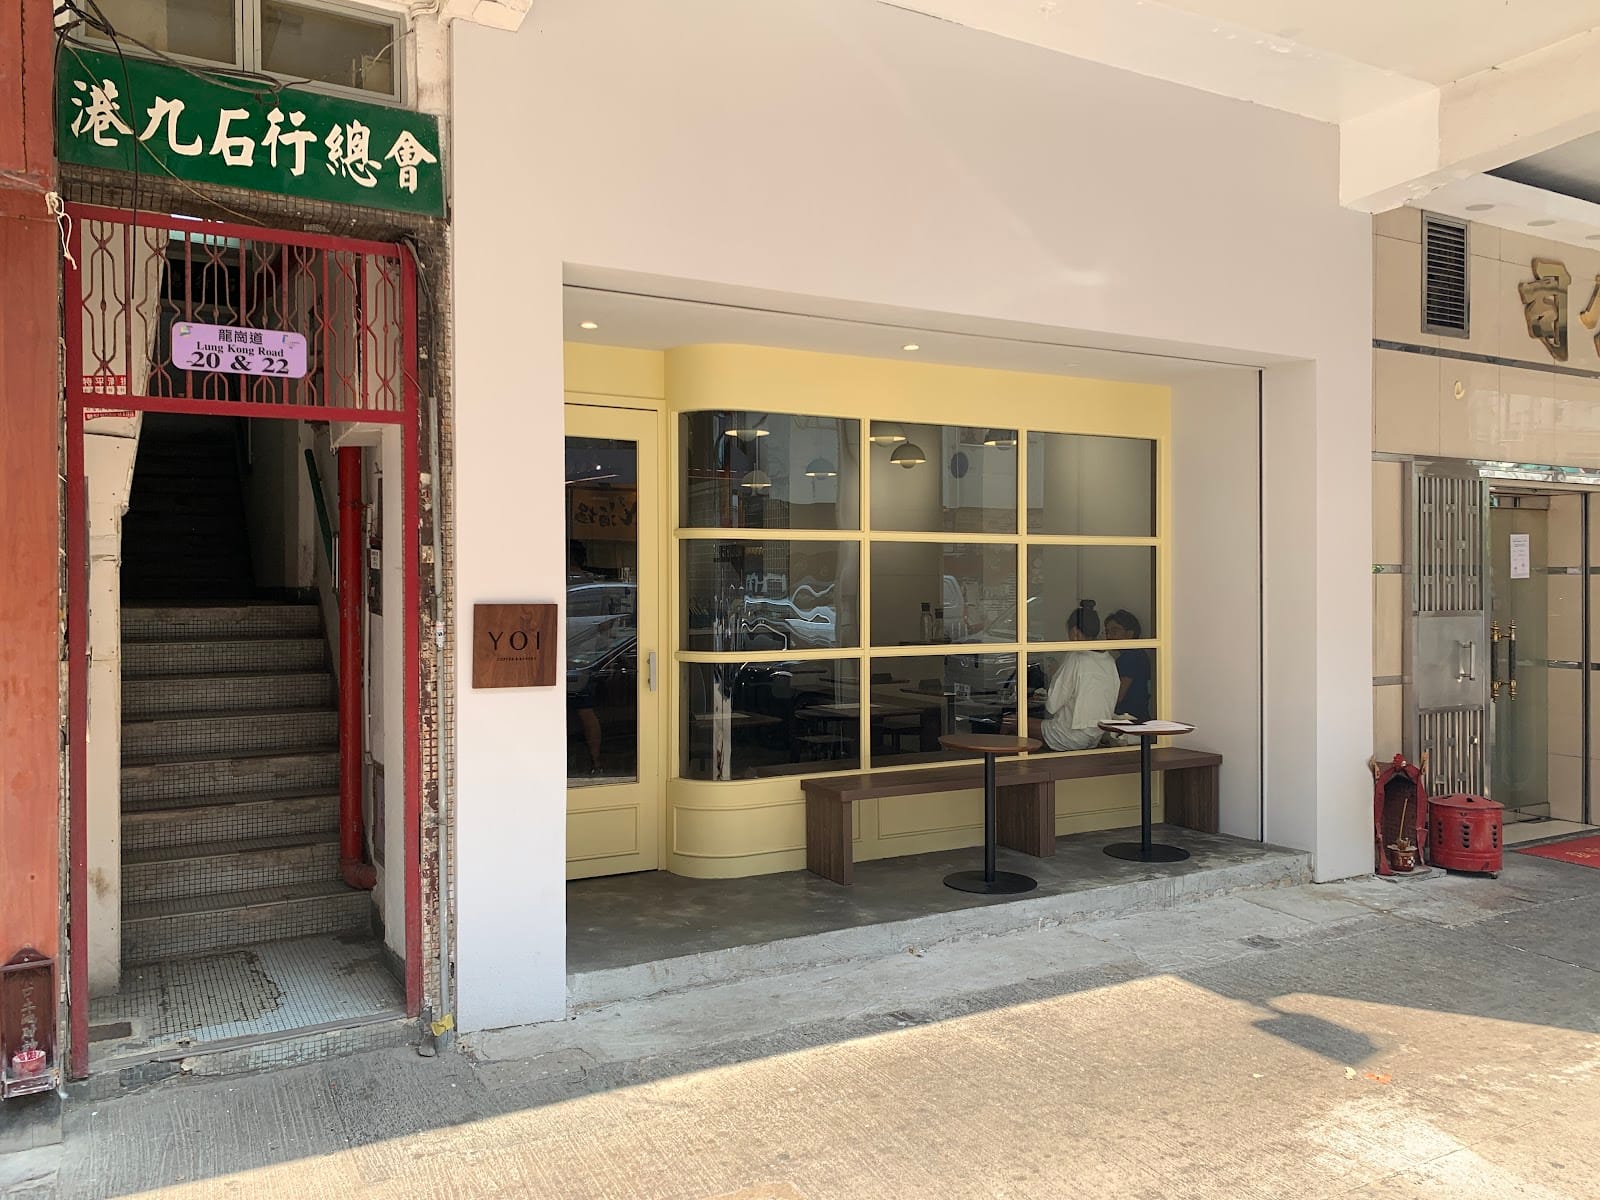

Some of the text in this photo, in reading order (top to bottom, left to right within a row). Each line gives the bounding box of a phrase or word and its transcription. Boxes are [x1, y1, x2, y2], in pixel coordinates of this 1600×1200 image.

[70, 78, 438, 194] 港九石行總會
[218, 329, 263, 345] 龍崗道
[196, 341, 284, 357] Lung Kong Road
[191, 351, 289, 375] 20 & 22
[488, 631, 540, 651] YOI
